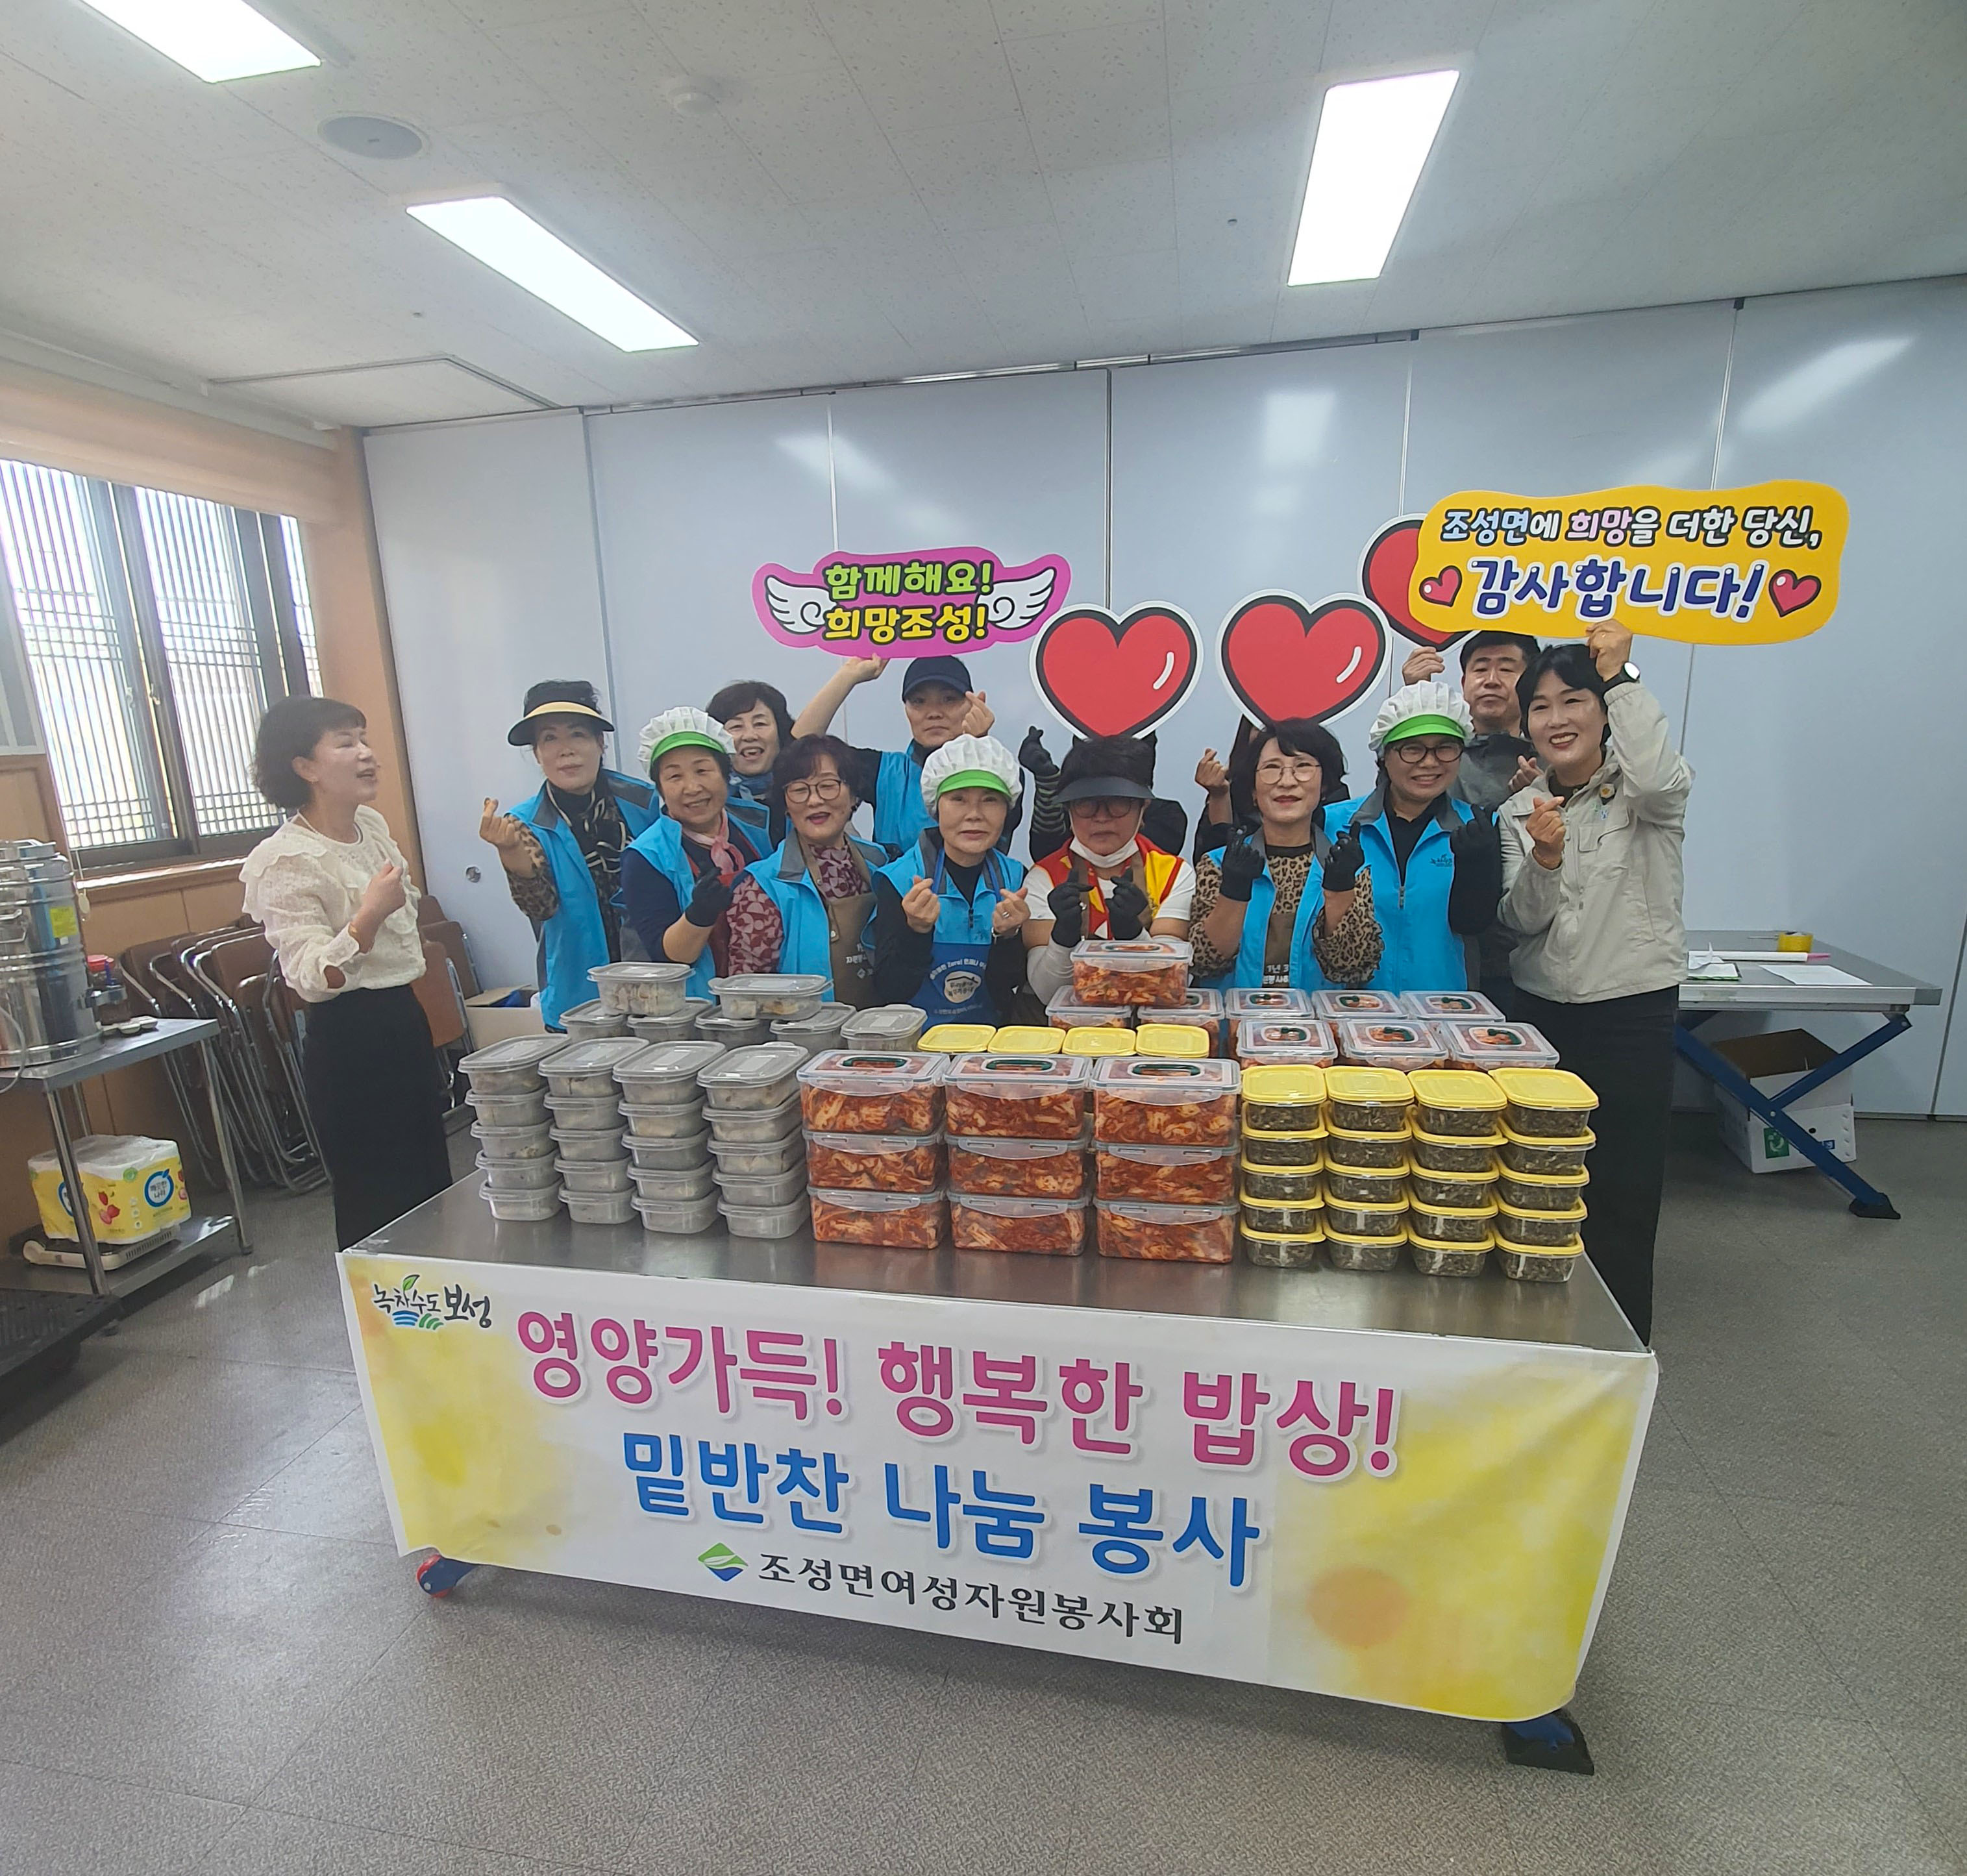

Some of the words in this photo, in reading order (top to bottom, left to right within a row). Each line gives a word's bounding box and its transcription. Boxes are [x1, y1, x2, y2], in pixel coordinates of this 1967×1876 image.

[1442, 510, 1558, 541] 조성면에
[1567, 507, 1659, 545] 희망을
[1668, 508, 1735, 543] 더한
[1744, 506, 1822, 548] 당신,
[824, 561, 993, 600] 함께해요!
[1470, 558, 1766, 619] 감사합니다!
[824, 604, 986, 644] 희망조성!
[373, 1283, 441, 1314] 녹차수도
[443, 1283, 492, 1329] 보성
[518, 1310, 843, 1421] 영양가득!
[878, 1340, 1144, 1455] 행복한
[1182, 1371, 1394, 1477] 밥상!
[623, 1431, 849, 1534] 밑반찬
[884, 1463, 1045, 1559] 나눔
[1078, 1483, 1260, 1588] 봉사
[758, 1552, 1182, 1644] 조성면여성자원봉사회
